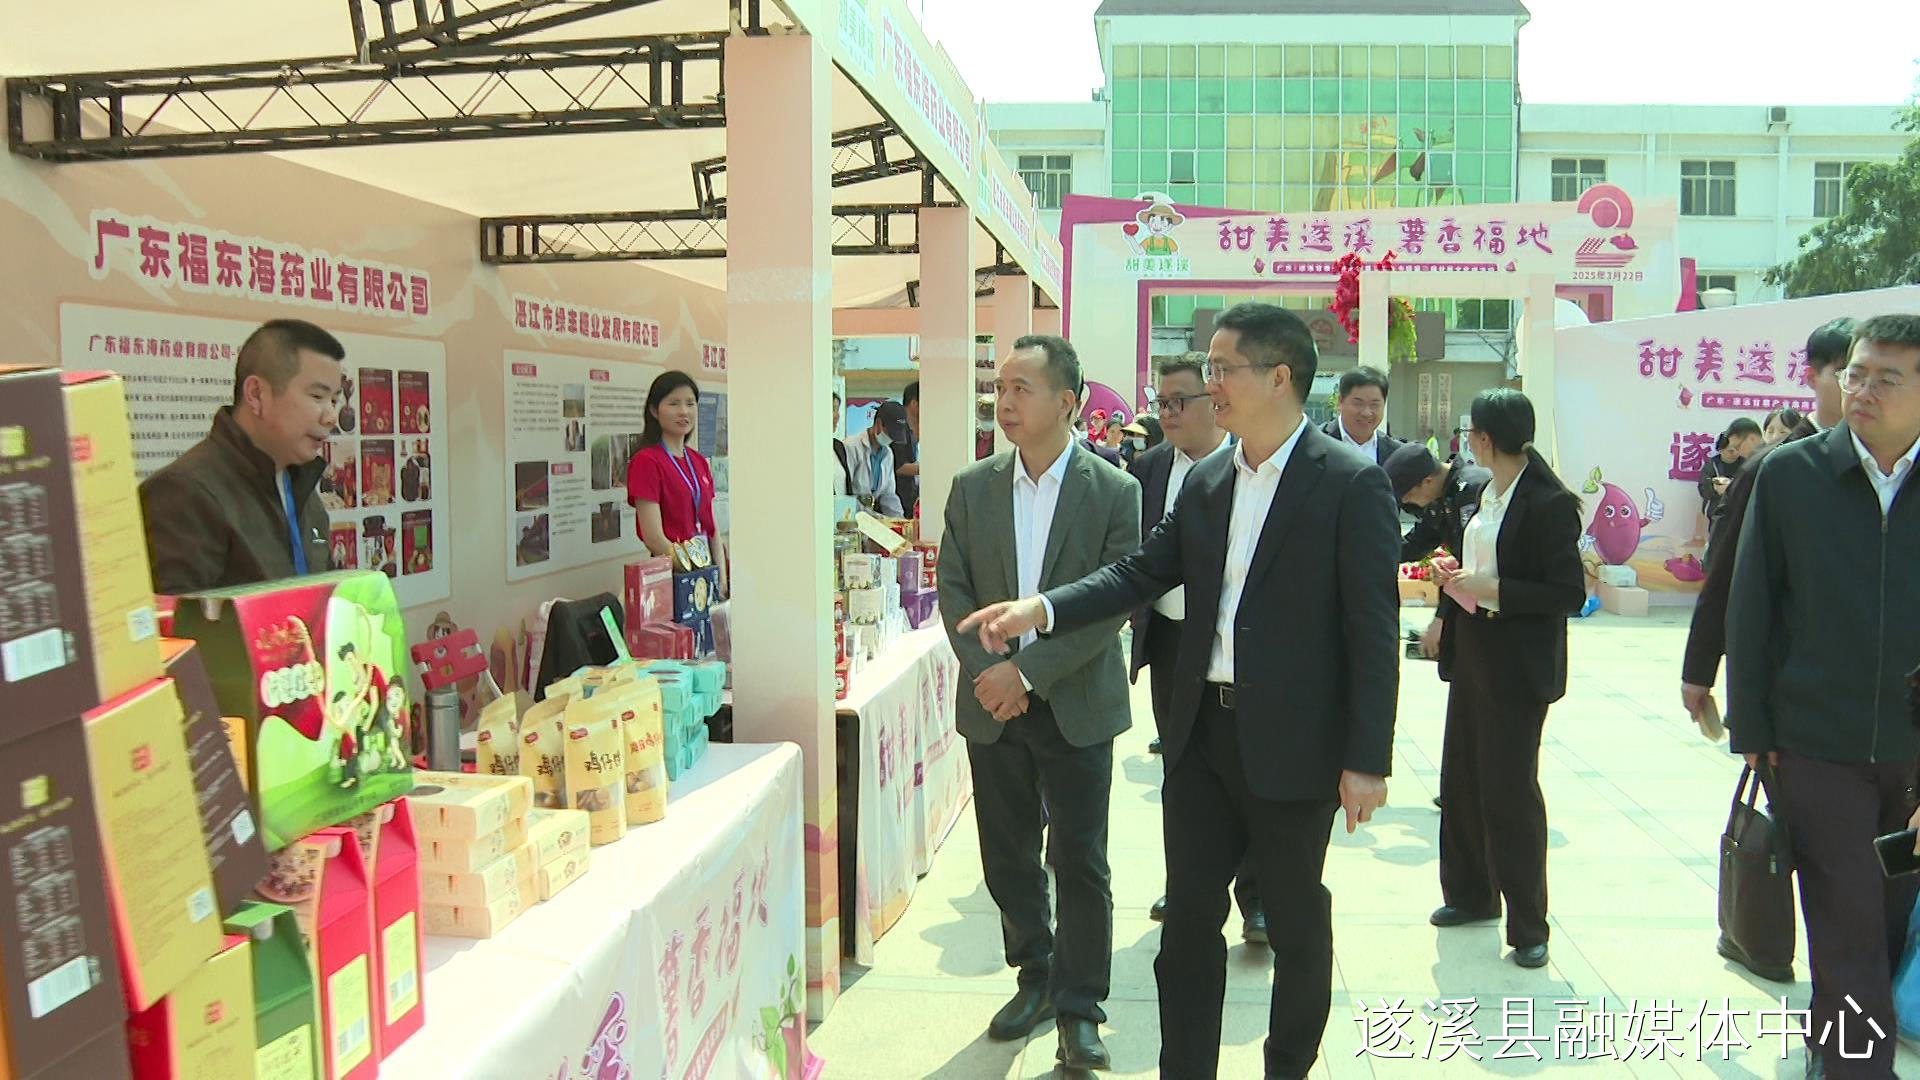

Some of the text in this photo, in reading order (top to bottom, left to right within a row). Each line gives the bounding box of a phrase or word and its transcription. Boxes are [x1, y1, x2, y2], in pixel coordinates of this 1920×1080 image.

[94, 218, 429, 316] 广东福东海药业有限公司
[1398, 217, 1553, 255] 薯香福地
